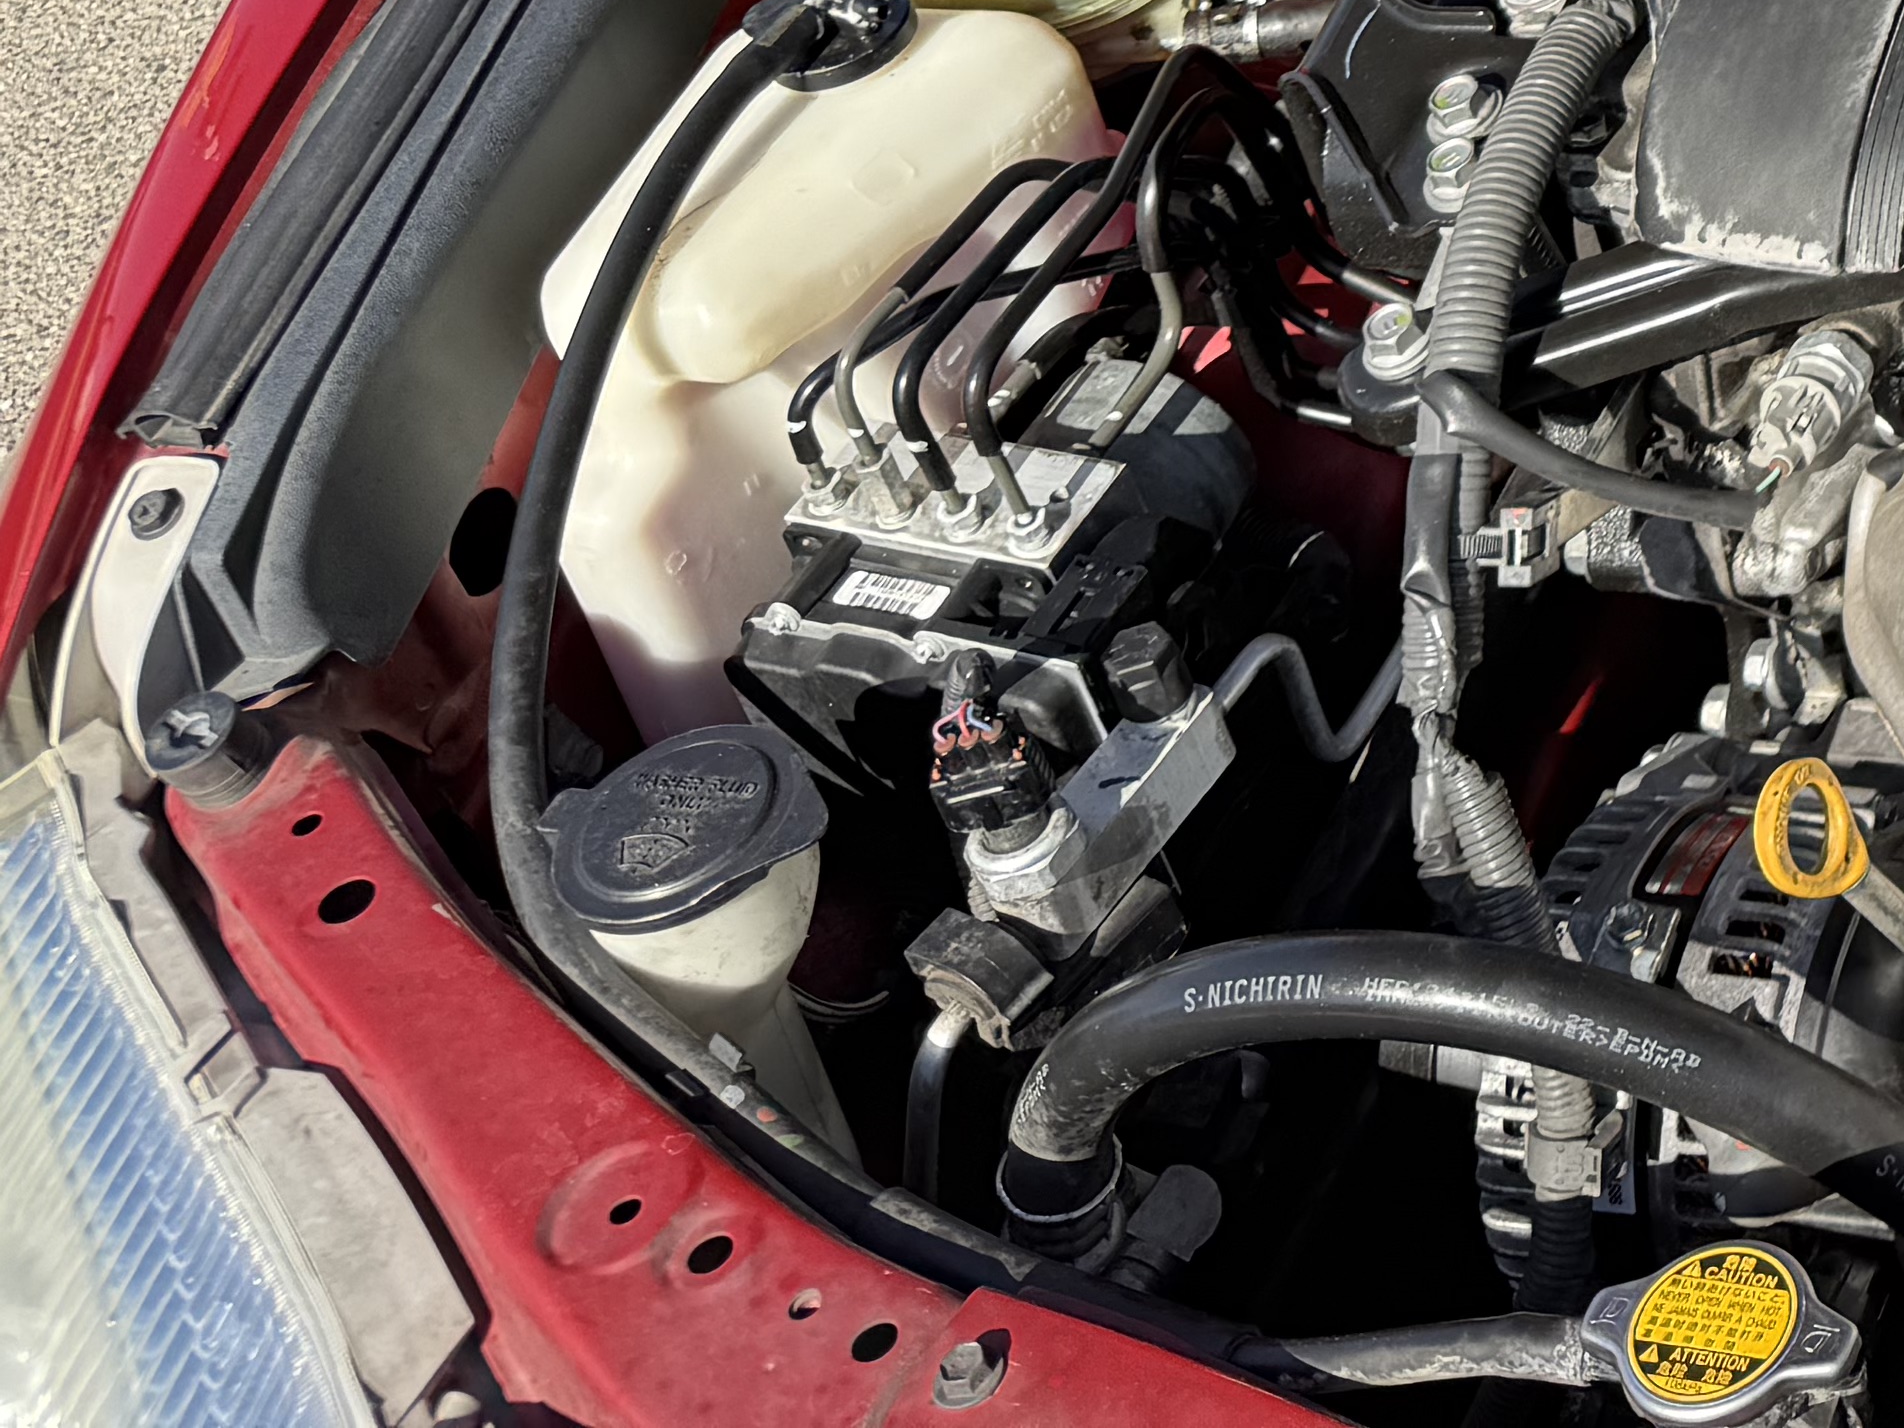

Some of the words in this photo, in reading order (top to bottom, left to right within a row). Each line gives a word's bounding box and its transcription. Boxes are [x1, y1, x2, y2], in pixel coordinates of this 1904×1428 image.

[1704, 1266, 1779, 1289] CAUTION
[1760, 1304, 1783, 1318] HOT
[1668, 1347, 1751, 1373] ATTENTION
